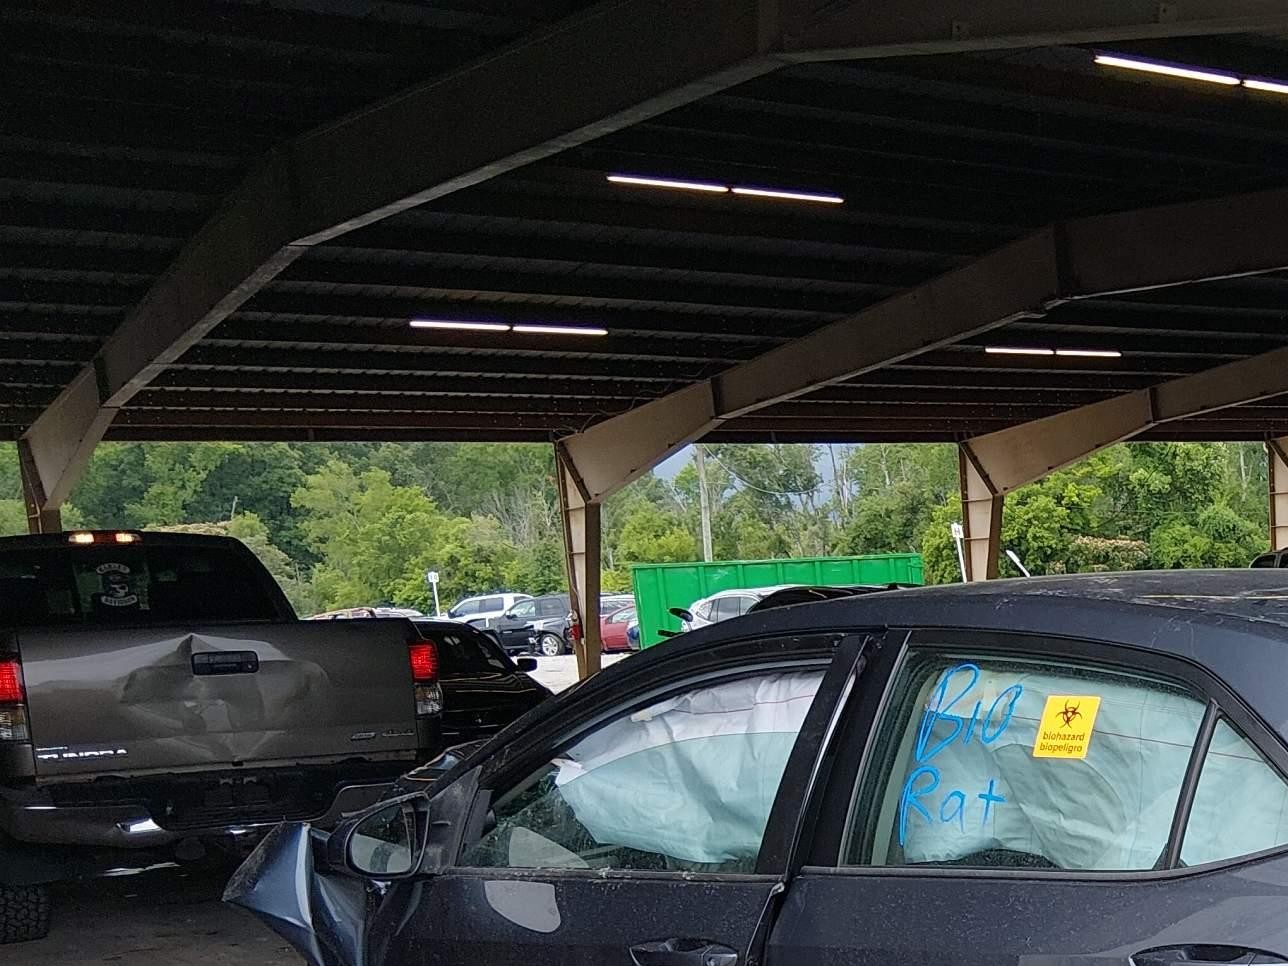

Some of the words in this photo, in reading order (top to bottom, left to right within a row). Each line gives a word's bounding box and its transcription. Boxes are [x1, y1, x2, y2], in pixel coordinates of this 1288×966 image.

[1042, 731, 1085, 742] biohazard
[1039, 742, 1083, 754] biopeligro
[899, 765, 1007, 847] Rat
